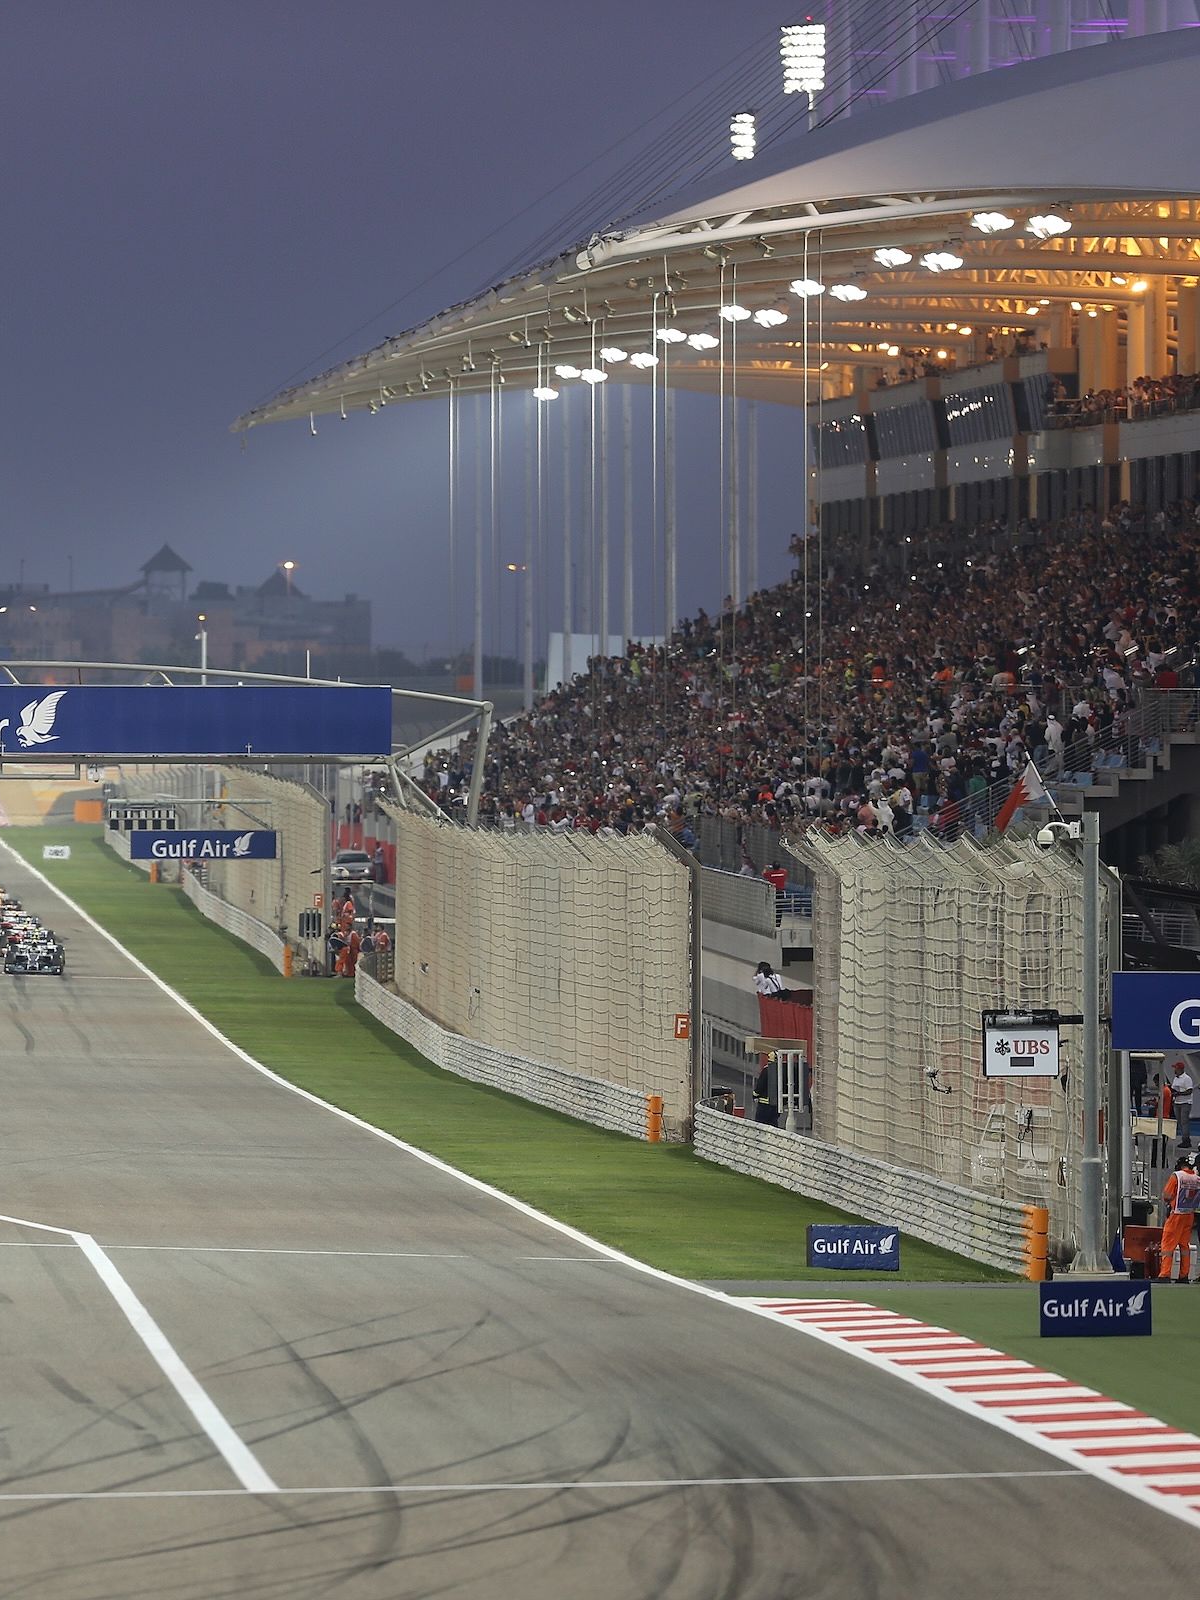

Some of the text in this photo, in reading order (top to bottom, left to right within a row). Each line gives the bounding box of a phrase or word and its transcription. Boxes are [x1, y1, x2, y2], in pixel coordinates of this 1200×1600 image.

[151, 839, 230, 858] Gulf Air
[315, 895, 321, 906] F
[677, 1018, 688, 1035] F
[1170, 999, 1200, 1044] G
[1012, 1039, 1050, 1055] UBS
[813, 1238, 877, 1255] Gulf Air
[1043, 1299, 1123, 1318] Gulf Air
